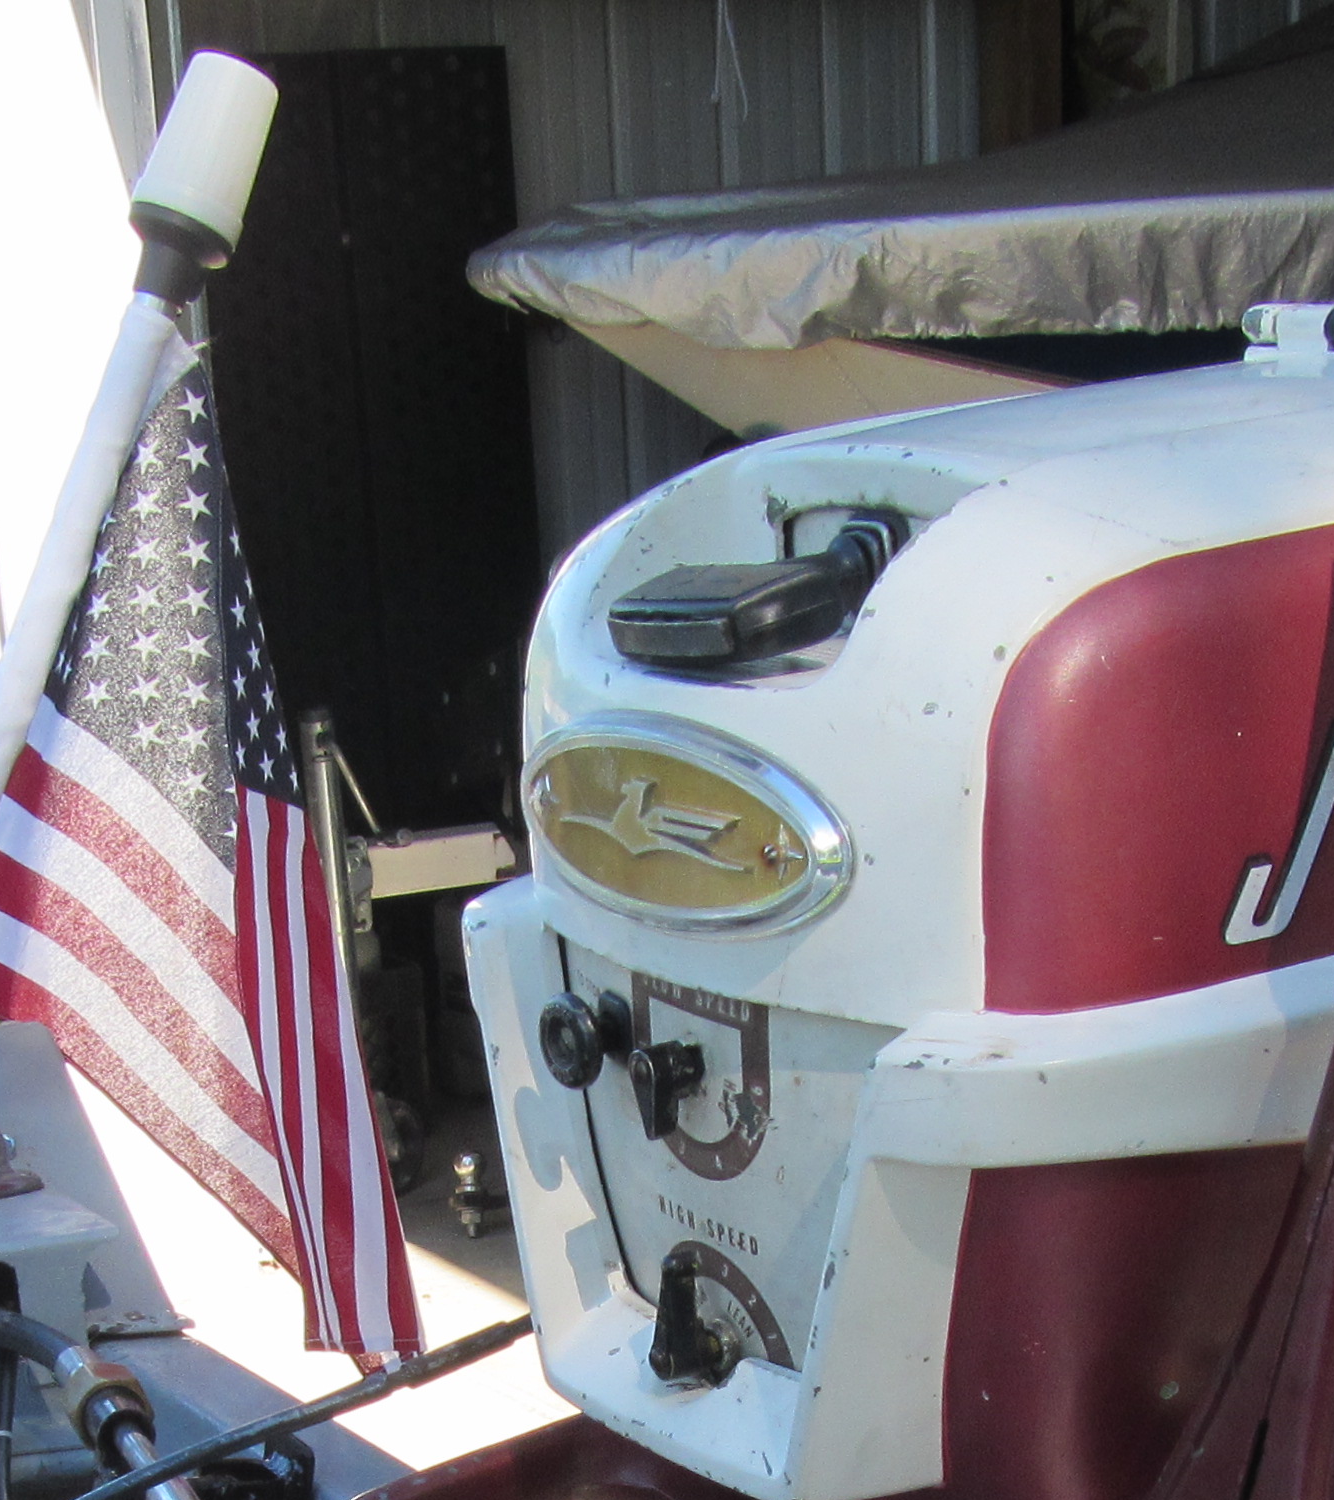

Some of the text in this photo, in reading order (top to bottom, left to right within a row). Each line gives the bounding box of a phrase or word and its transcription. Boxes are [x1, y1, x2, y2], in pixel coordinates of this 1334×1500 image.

[657, 1194, 759, 1256] HIGH SPEED
[727, 1300, 755, 1338] LEAN
